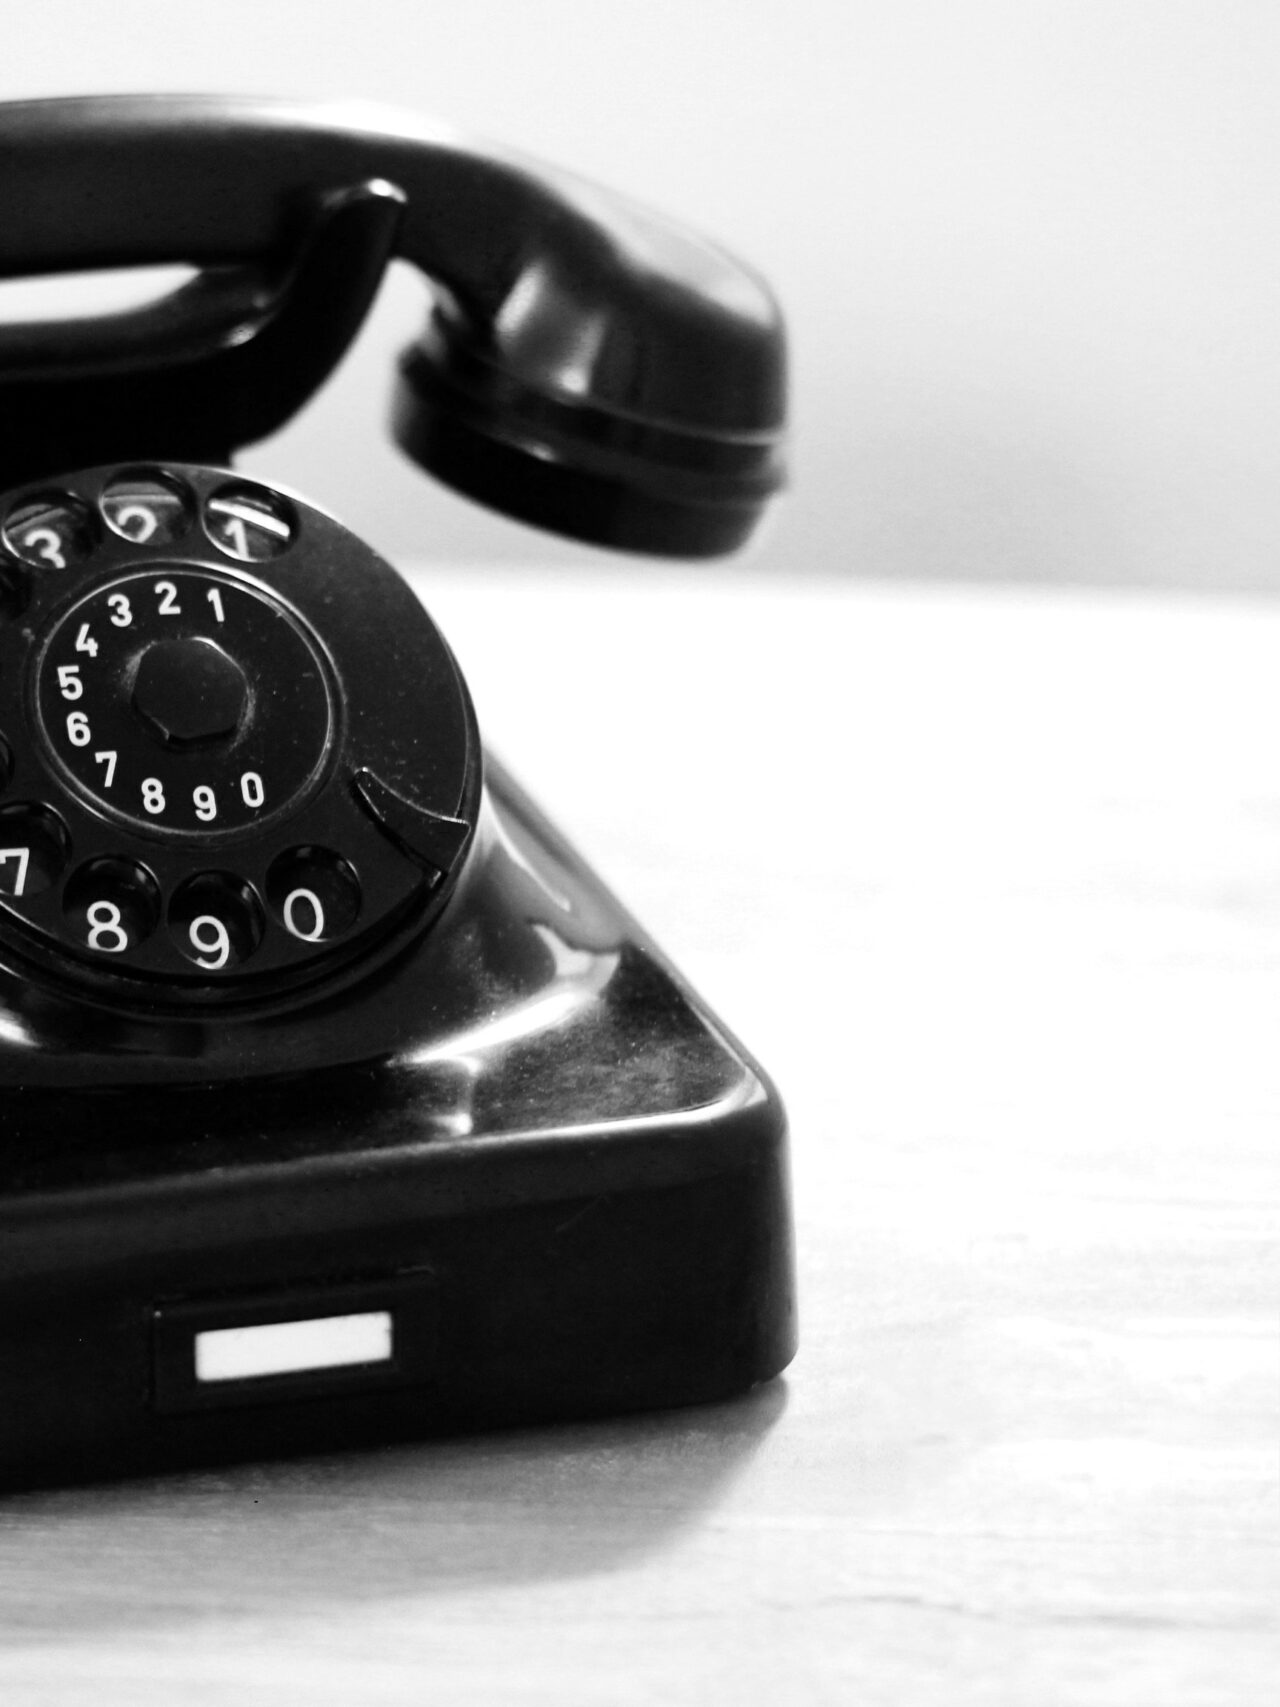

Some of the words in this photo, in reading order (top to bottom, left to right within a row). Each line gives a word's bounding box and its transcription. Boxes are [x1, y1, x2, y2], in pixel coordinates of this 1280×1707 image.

[224, 520, 251, 560] 1
[106, 592, 134, 628] 3
[154, 580, 182, 616] 2
[206, 587, 225, 623] 1
[74, 622, 99, 658] 4
[56, 664, 84, 701] 5
[66, 711, 92, 747] 6
[94, 750, 118, 788] 7
[140, 777, 166, 815] 8
[192, 785, 218, 822] 9
[240, 771, 265, 808] 0
[86, 900, 129, 952] 8
[282, 887, 326, 941] 0
[188, 914, 230, 970] 9
